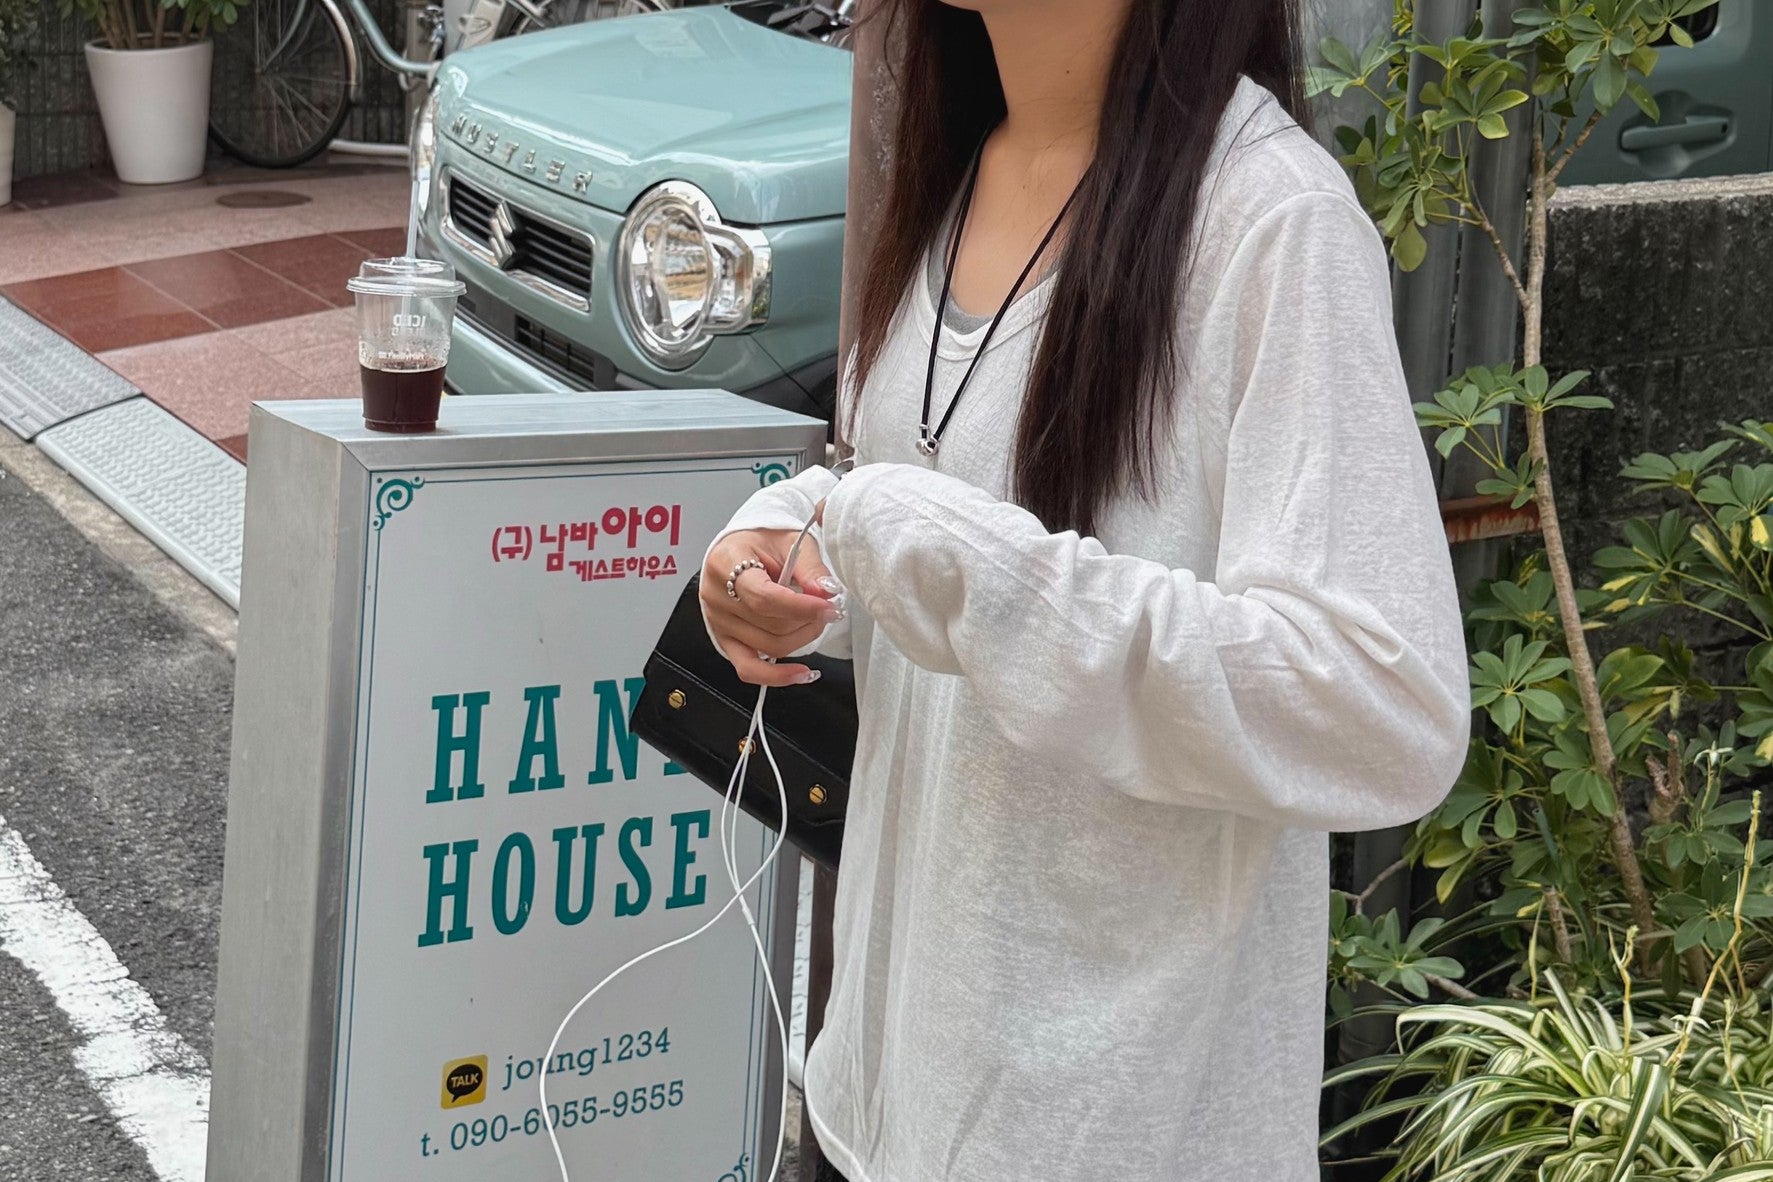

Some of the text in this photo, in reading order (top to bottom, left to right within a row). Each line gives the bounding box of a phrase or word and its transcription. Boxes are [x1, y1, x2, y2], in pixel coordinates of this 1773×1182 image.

[452, 112, 594, 195] HUSTLER
[492, 505, 681, 572] (구) 남바아이
[568, 554, 678, 582] 게스트하우스
[425, 676, 690, 804] HAN
[417, 809, 711, 948] HOUSE
[450, 1073, 481, 1089] TALK
[502, 1026, 671, 1091] joung1234
[420, 1079, 684, 1157] t. 090-6055-9555
